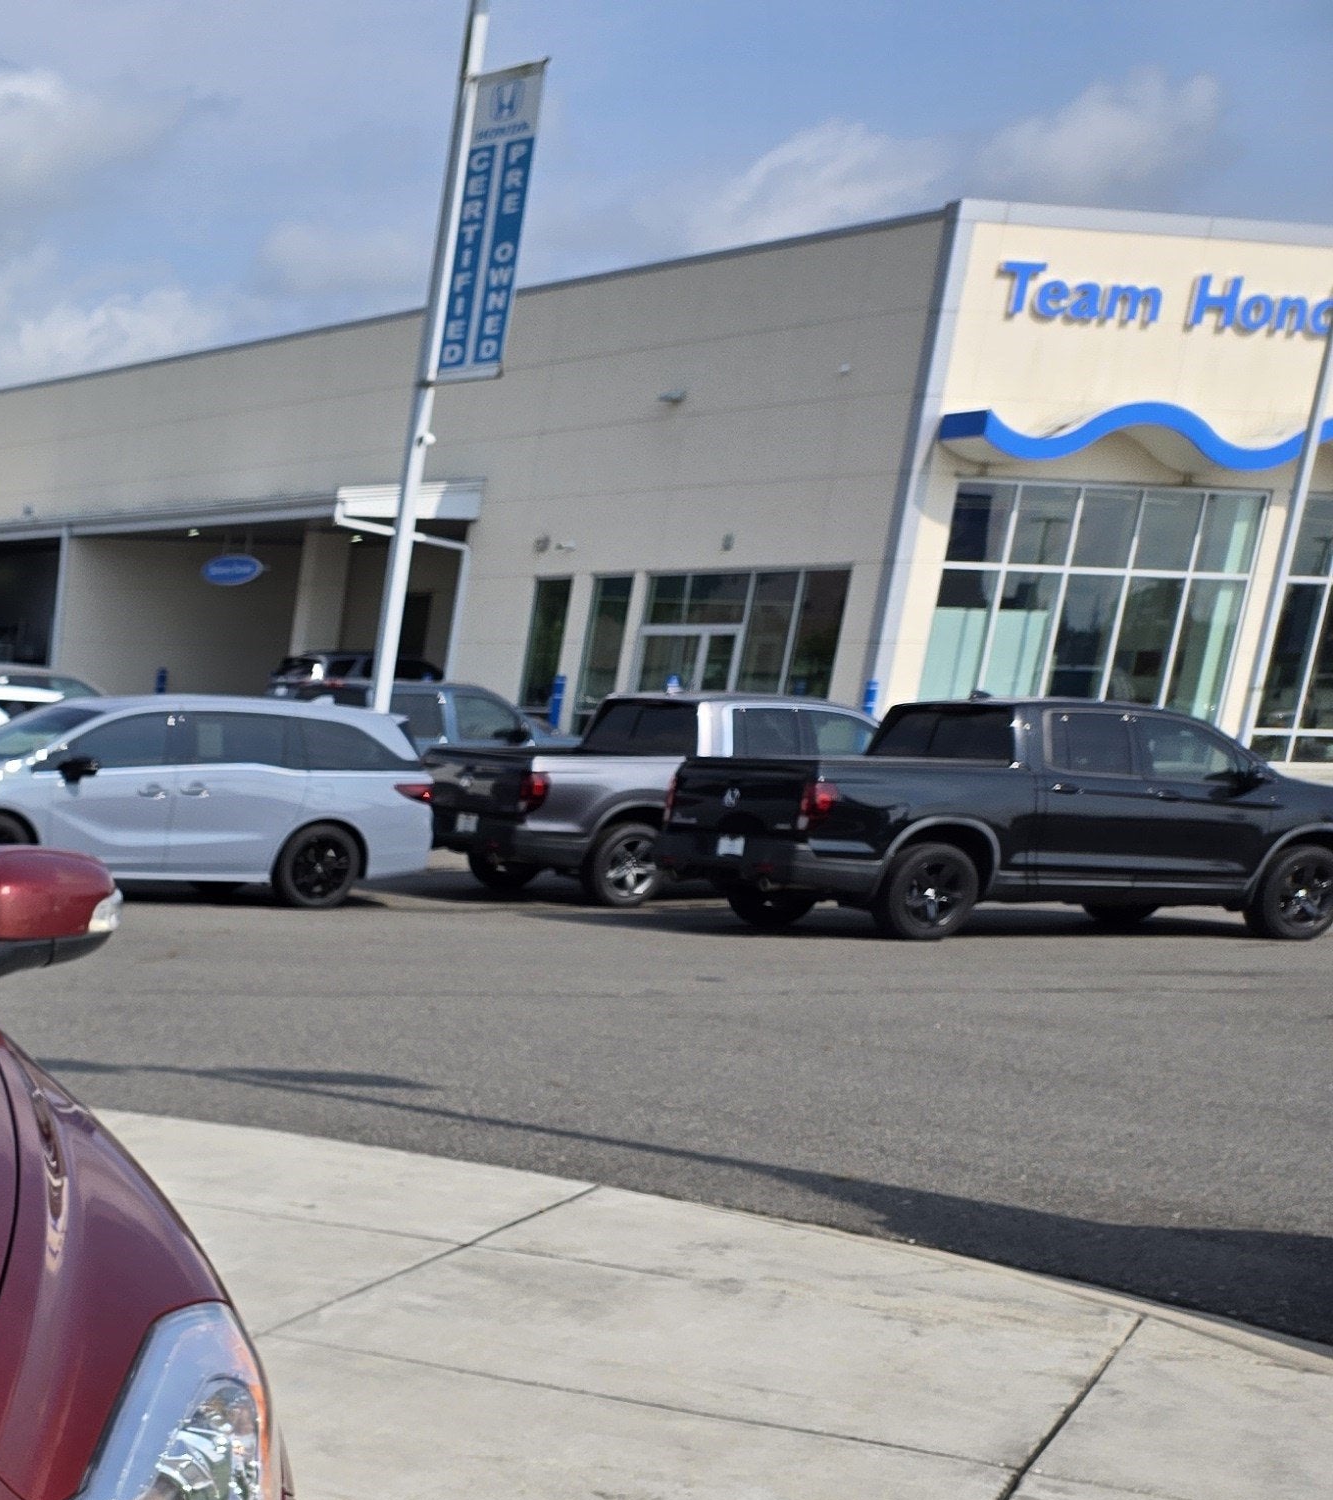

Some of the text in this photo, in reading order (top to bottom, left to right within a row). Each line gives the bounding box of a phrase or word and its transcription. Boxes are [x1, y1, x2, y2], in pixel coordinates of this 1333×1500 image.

[442, 151, 493, 365] CERTIFIED
[478, 143, 528, 361] PRE OWNED
[1001, 260, 1163, 323] Team
